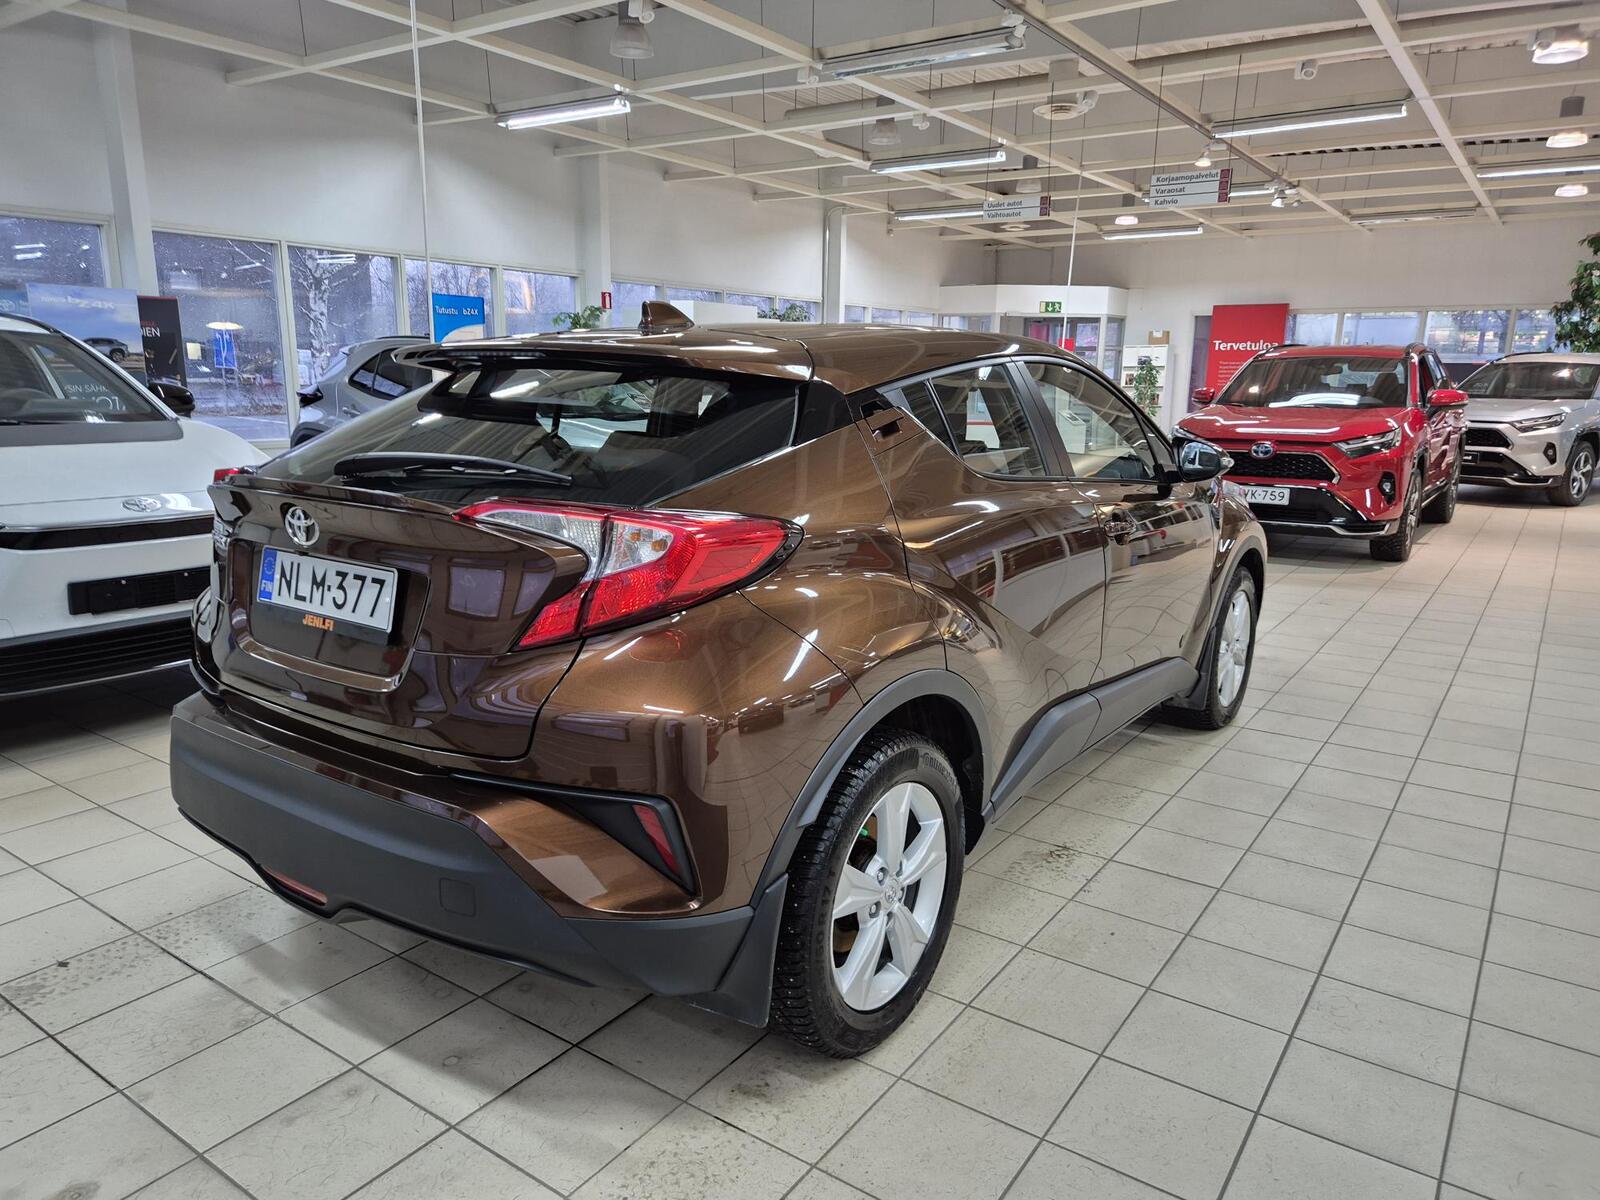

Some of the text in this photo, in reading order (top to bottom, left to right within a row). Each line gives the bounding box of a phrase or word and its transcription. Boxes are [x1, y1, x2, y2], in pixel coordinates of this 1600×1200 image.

[1156, 171, 1219, 183] Korjaamopalvelut
[1155, 186, 1186, 195] Varaosat
[1154, 198, 1179, 206] Kahvio
[987, 211, 1022, 219] Vaihtoautot
[435, 305, 459, 315] Tutustu
[260, 579, 273, 593] FIN
[277, 560, 386, 618] NLM-377
